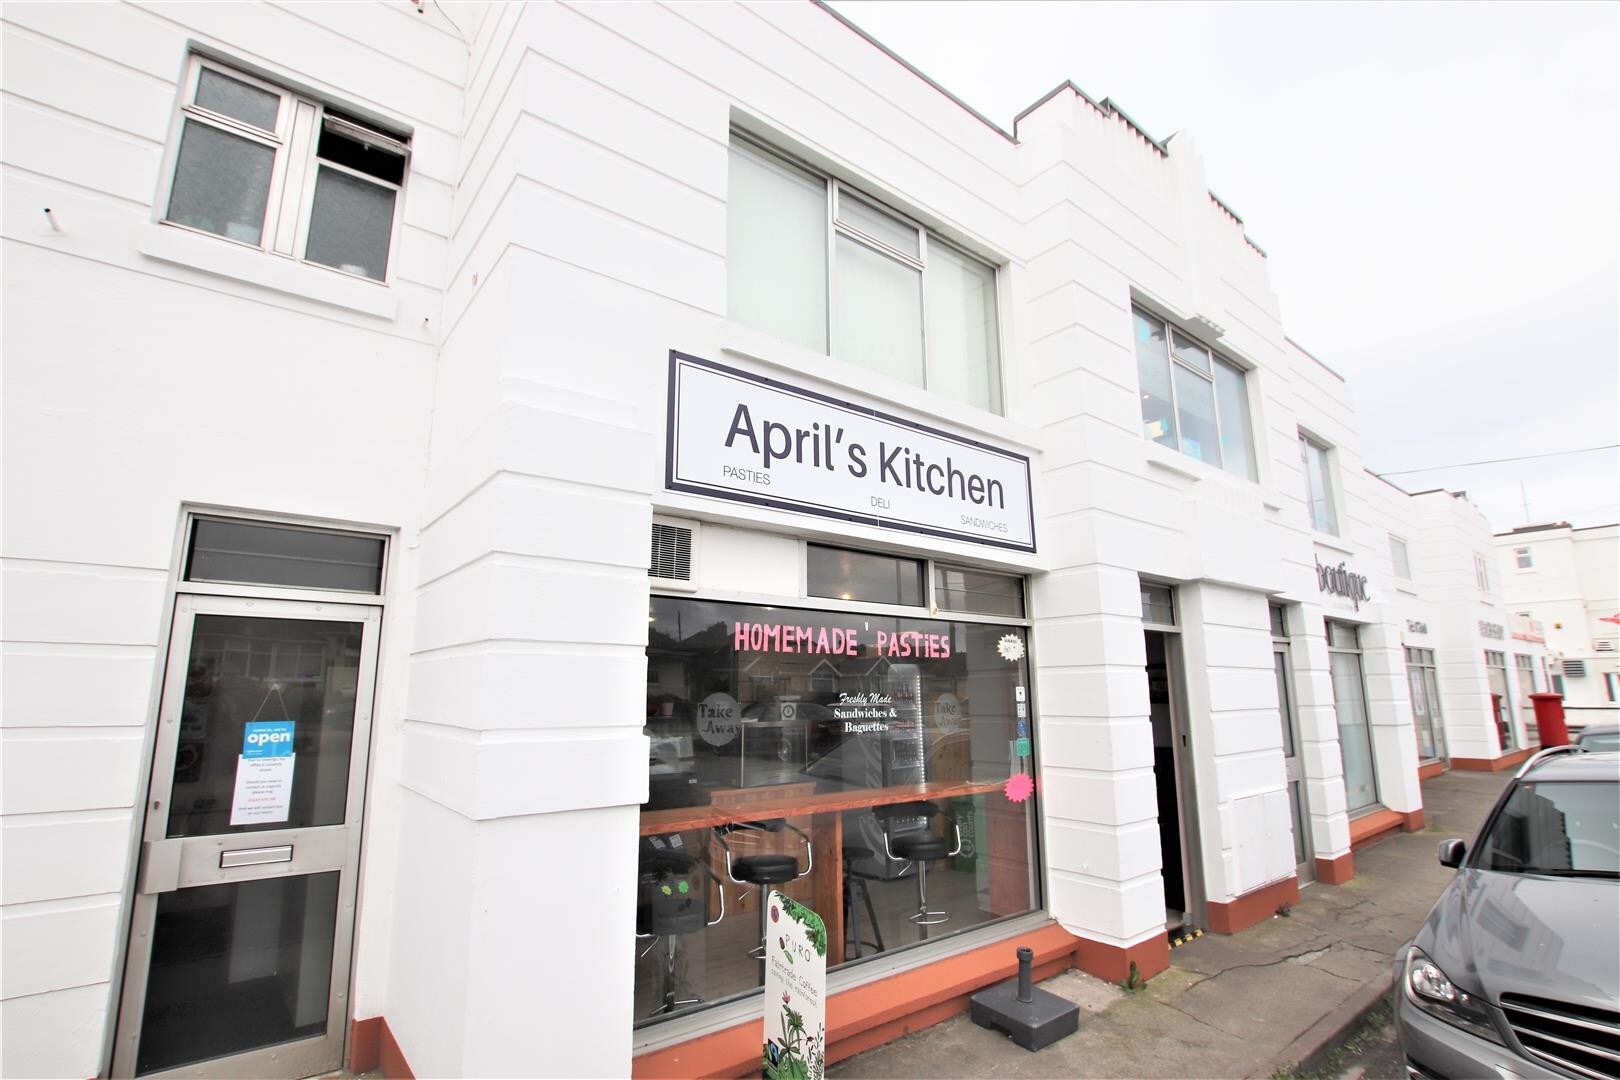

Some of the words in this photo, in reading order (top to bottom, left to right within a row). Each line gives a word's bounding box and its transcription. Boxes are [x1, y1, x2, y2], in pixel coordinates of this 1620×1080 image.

[724, 403, 868, 478] April’s
[880, 441, 1006, 509] Kitchen
[723, 465, 771, 485] PASTIES
[870, 495, 891, 509] DELI
[960, 514, 1008, 533] SANDWICHES
[1314, 553, 1371, 612] boutique
[734, 621, 857, 656] HOMEMADE
[839, 692, 868, 706] Freshly
[869, 692, 892, 704] Made
[698, 704, 733, 718] Take
[833, 708, 888, 718] Sandwiches
[889, 708, 897, 718] &
[702, 720, 742, 738] Away
[845, 721, 889, 735] Baguettes
[247, 732, 291, 746] open
[785, 934, 811, 963] PURO
